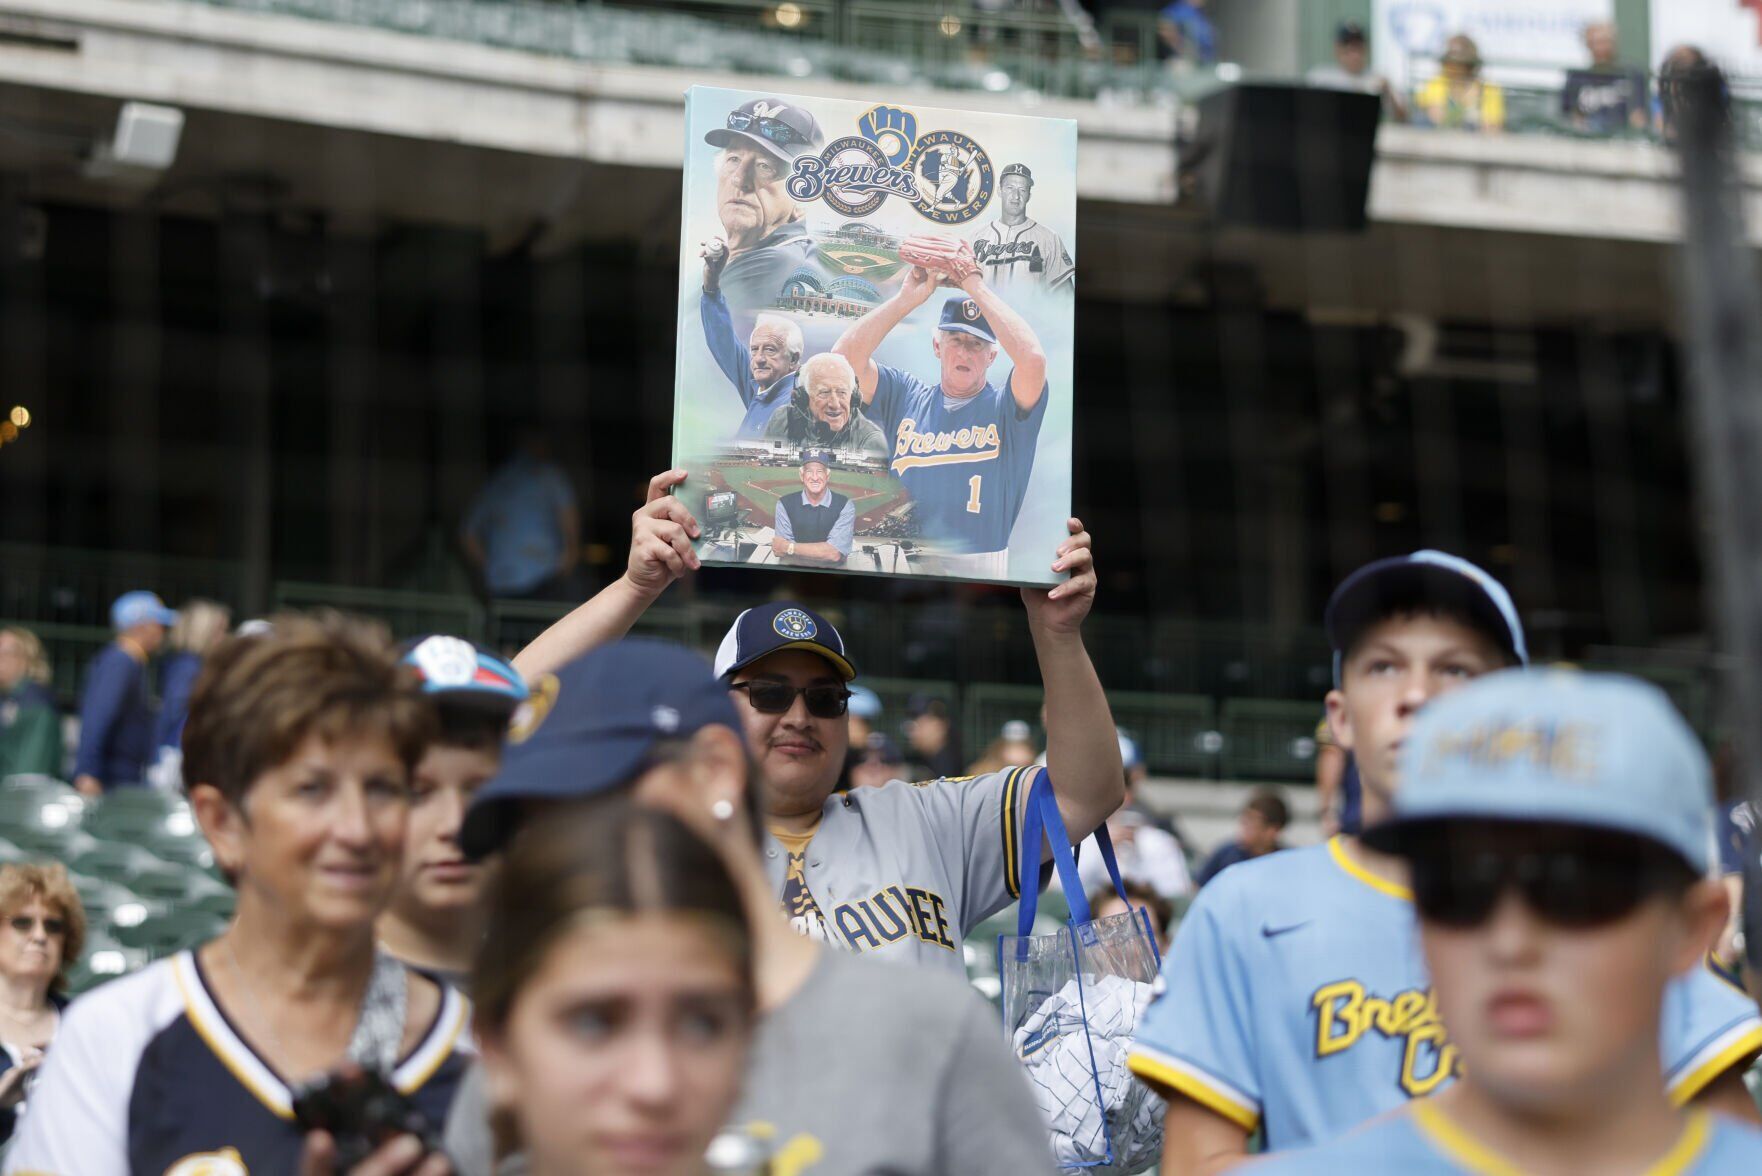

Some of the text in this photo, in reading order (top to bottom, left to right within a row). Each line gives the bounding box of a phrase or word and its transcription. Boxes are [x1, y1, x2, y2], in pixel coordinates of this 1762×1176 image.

[824, 140, 885, 167] MILWAUKEE
[786, 154, 921, 202] Brewers
[917, 190, 988, 221] REWERS
[893, 418, 1000, 458] Brewers
[967, 474, 982, 514] 1
